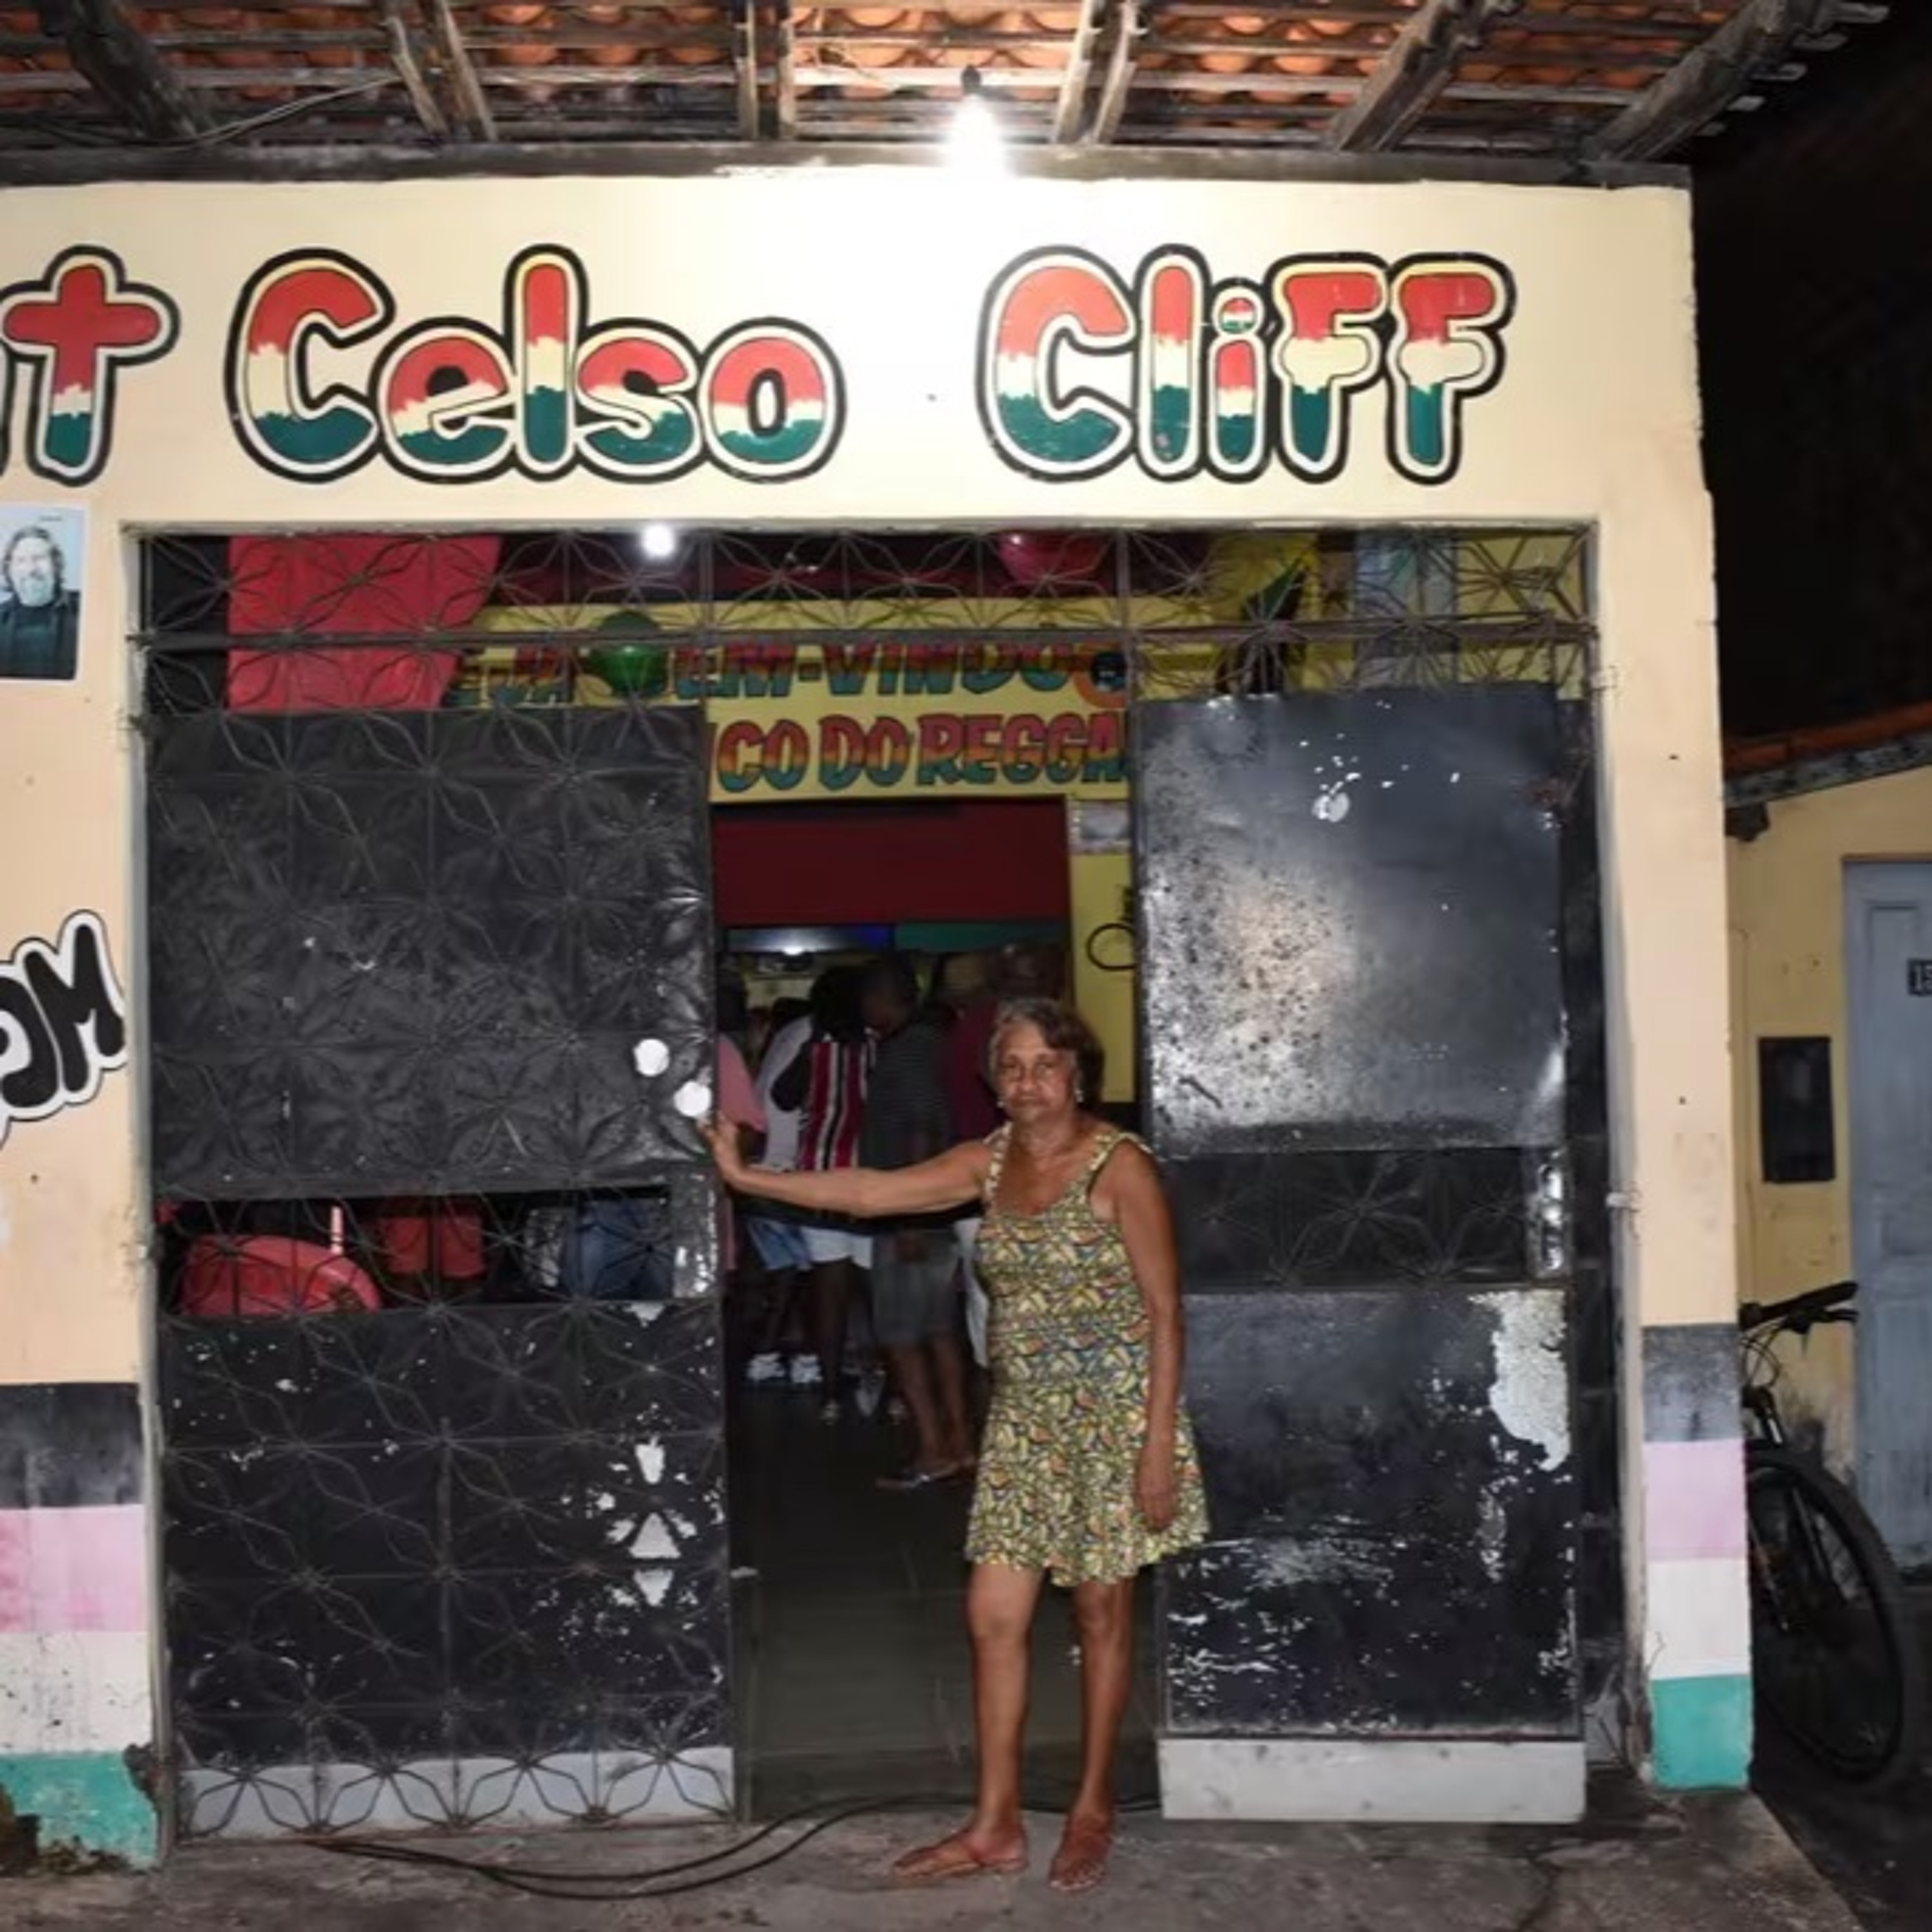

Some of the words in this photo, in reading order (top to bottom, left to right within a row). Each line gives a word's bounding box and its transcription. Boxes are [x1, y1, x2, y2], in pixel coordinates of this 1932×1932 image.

[0, 245, 180, 487] t
[224, 243, 848, 484] Celso
[708, 719, 810, 793] CO
[817, 714, 911, 791] DO
[916, 712, 1127, 786] REGGA
